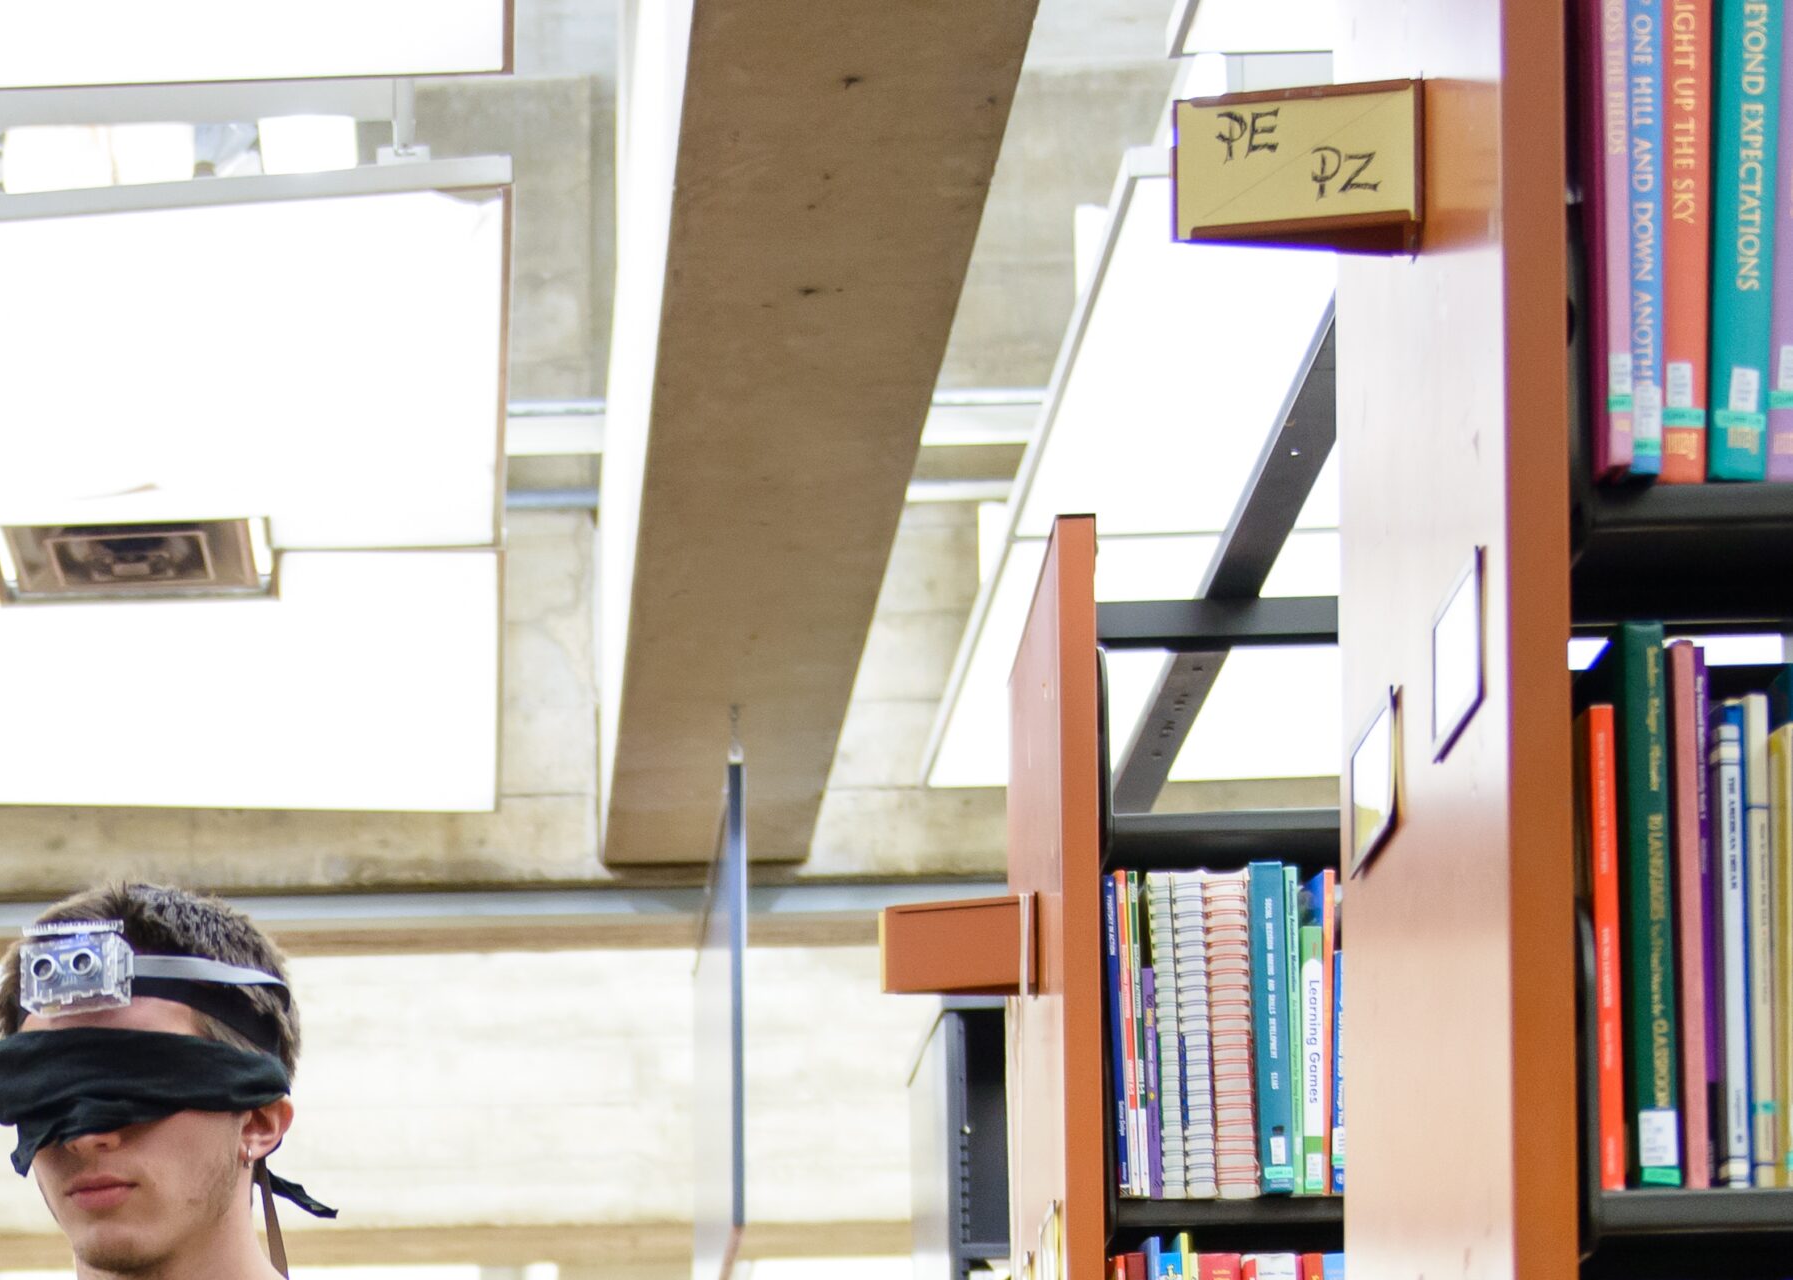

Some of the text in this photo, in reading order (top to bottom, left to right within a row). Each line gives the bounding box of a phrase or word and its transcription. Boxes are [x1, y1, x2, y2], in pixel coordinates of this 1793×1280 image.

[1672, 78, 1696, 111] UP
[1215, 107, 1280, 165] PE
[1631, 14, 1654, 281] ONE HILL AND DOWN
[1672, 117, 1696, 170] THE
[1310, 146, 1382, 201] PZ
[1671, 178, 1696, 224] SKY
[1736, 103, 1765, 291] EXPECTATIONS
[1269, 1018, 1278, 1058] DEVELOPMENT
[1307, 980, 1320, 1103] Learning Games
